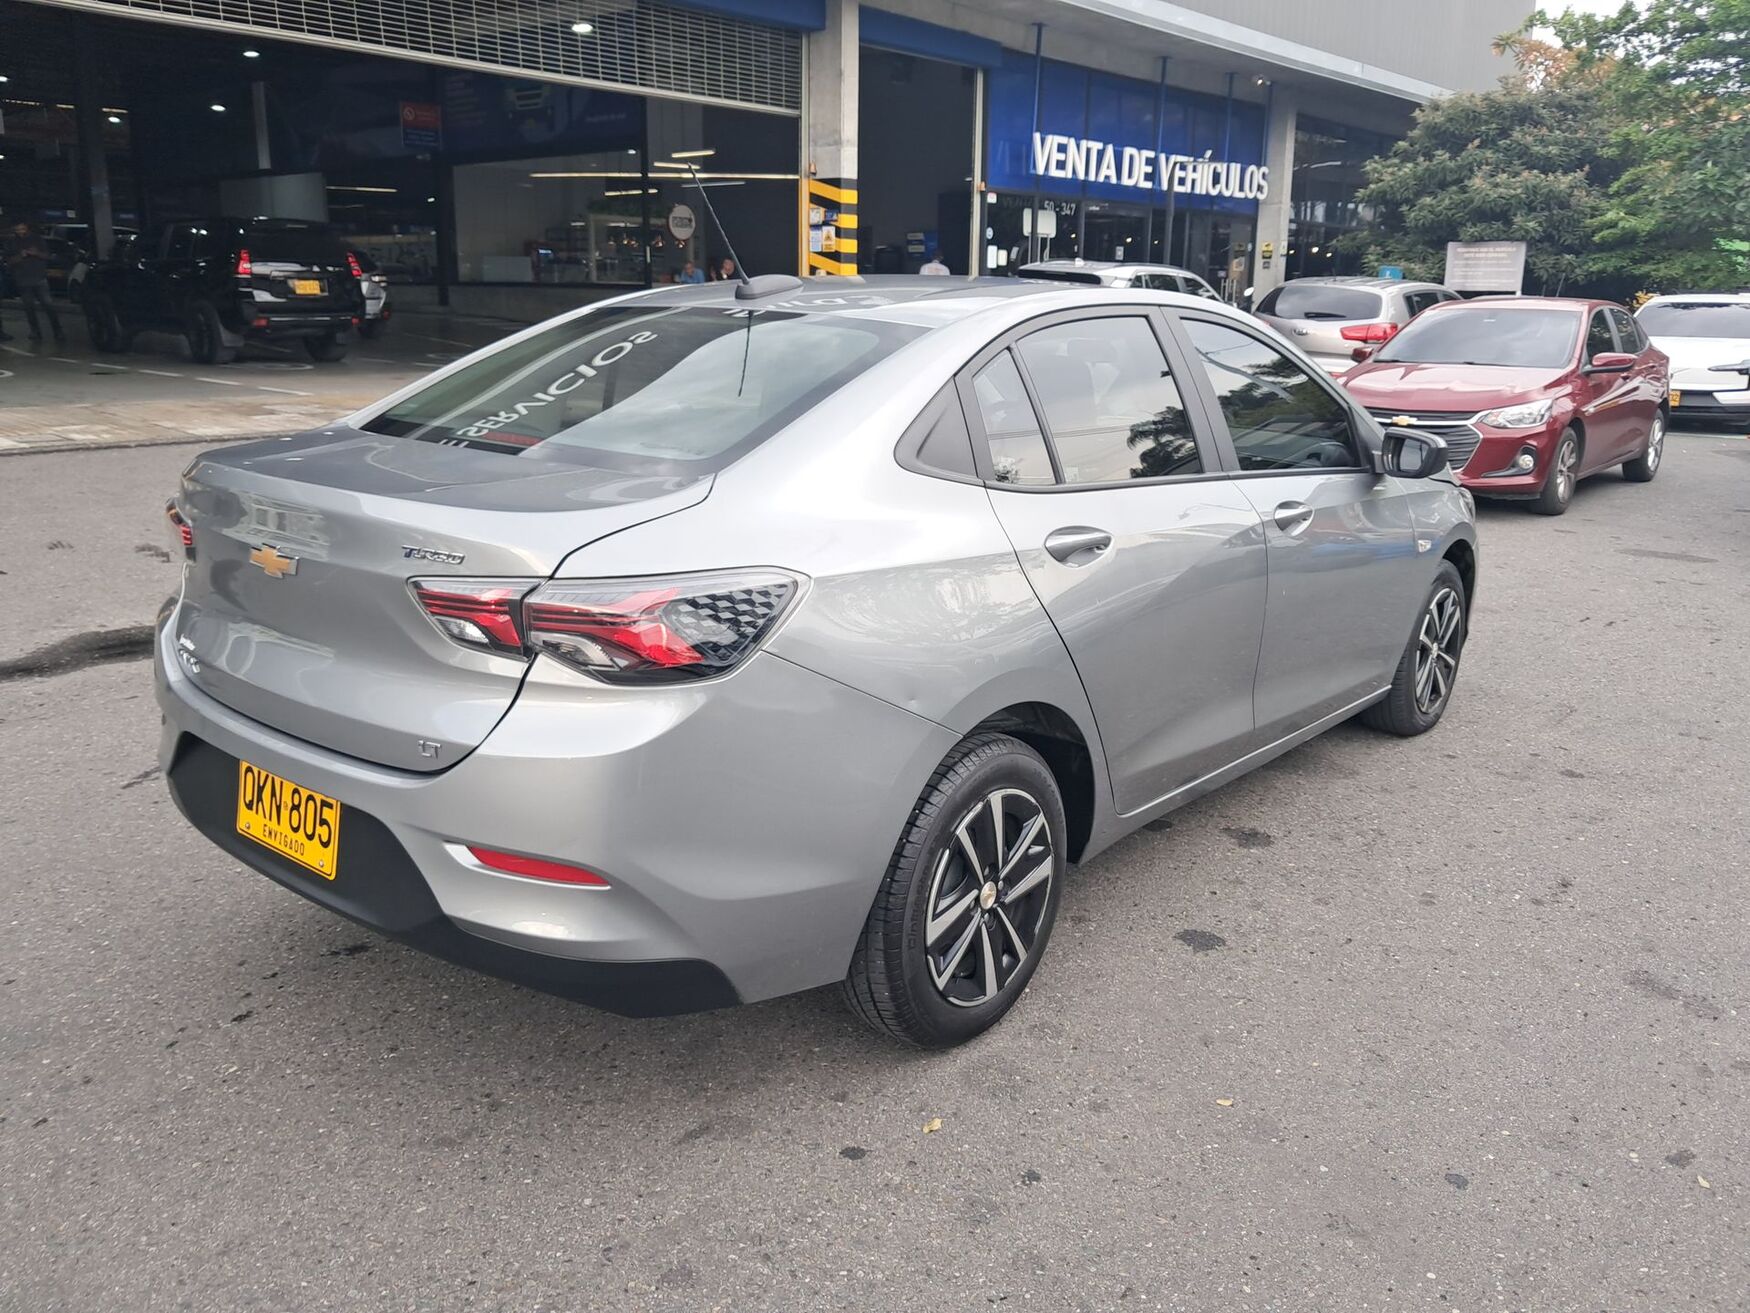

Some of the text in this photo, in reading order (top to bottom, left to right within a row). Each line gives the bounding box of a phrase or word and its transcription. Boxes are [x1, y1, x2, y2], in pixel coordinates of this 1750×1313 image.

[1033, 131, 1270, 200] VENTA DE VEHÍCULOS
[1061, 202, 1076, 216] 347
[418, 740, 442, 760] LT
[243, 766, 334, 849] QKN 805
[262, 824, 305, 856] ENVIGADO
